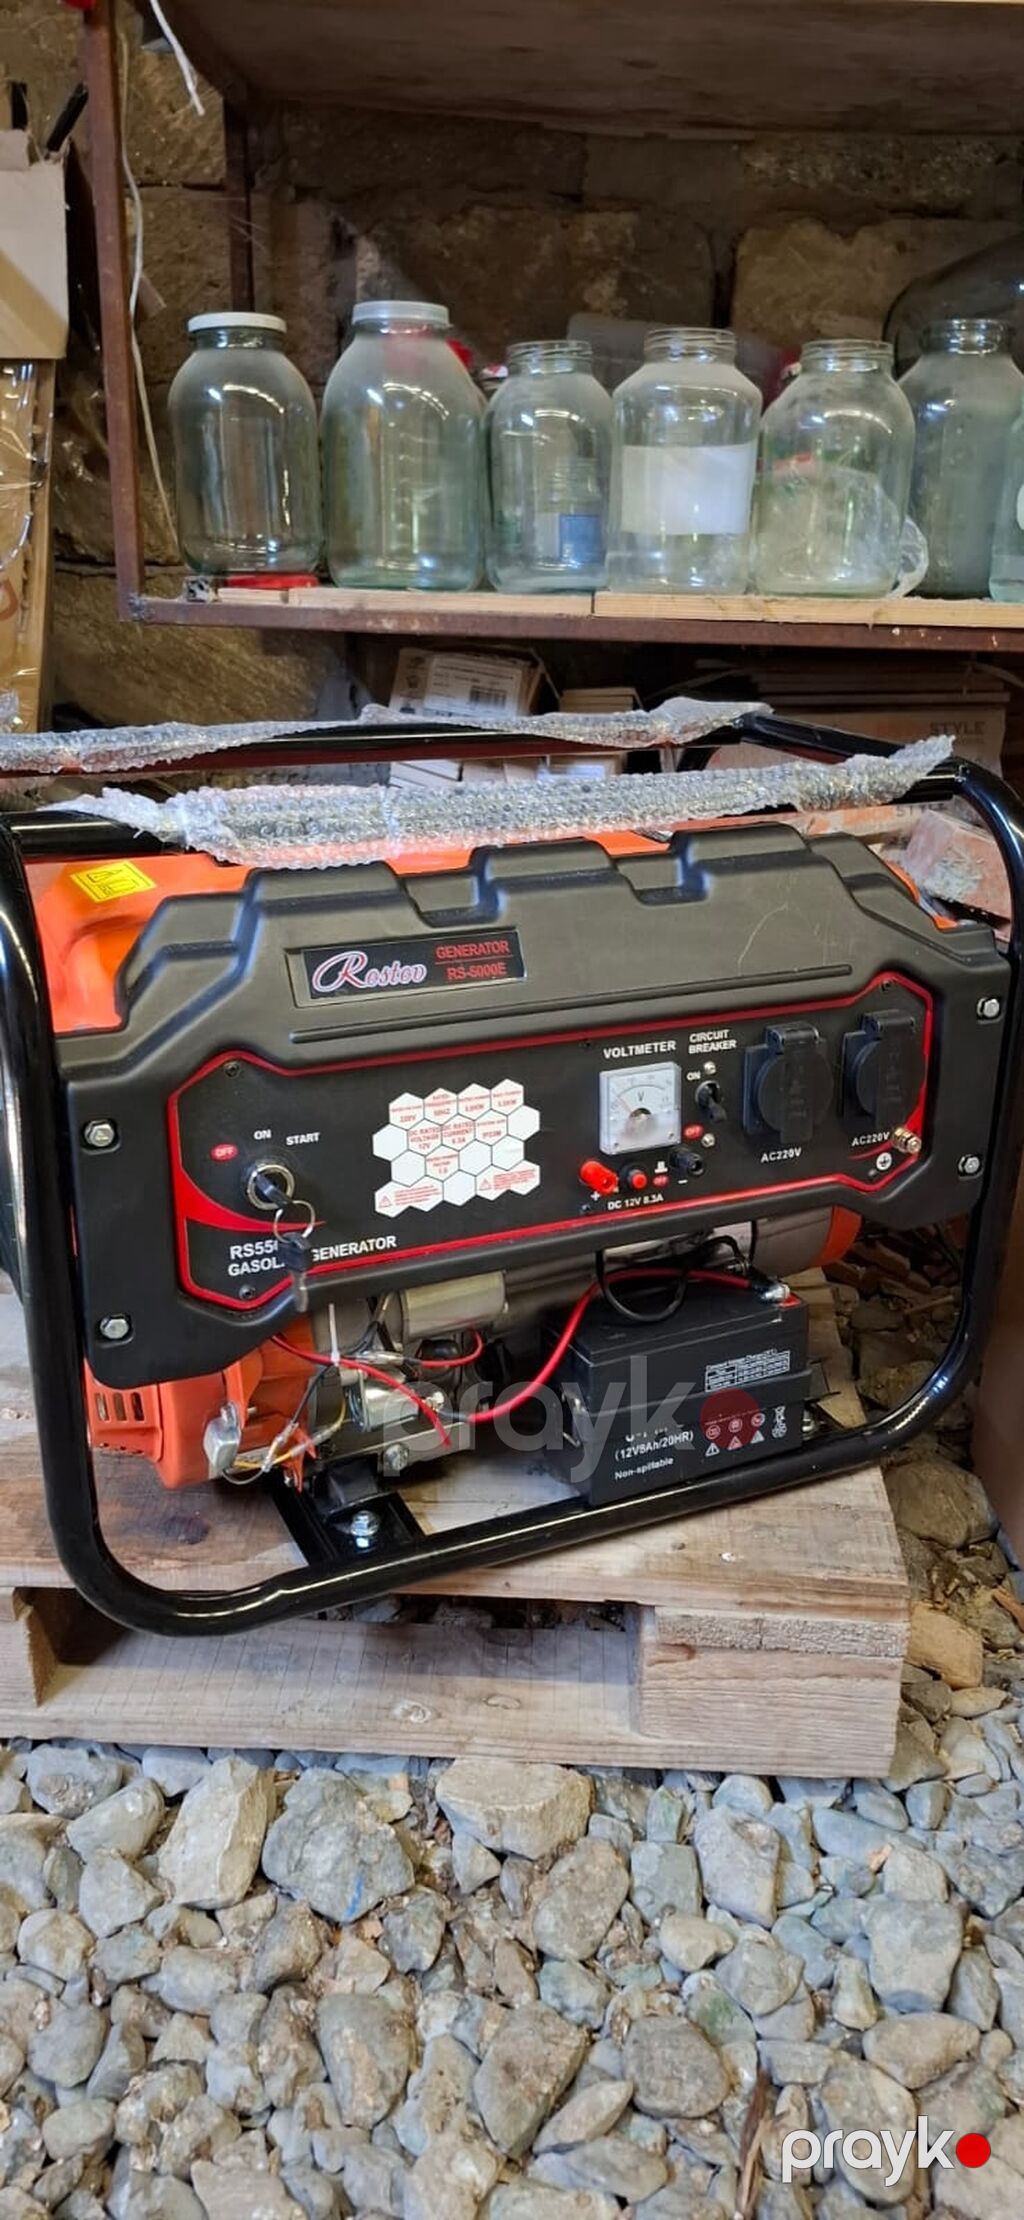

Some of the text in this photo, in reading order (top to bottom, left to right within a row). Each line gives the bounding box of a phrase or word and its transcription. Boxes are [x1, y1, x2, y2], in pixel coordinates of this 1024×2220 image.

[435, 940, 510, 959] GENERATOR
[312, 951, 427, 993] Rostov
[447, 961, 507, 980] RS-5000E
[689, 1029, 730, 1043] CIRCUIT
[603, 1040, 676, 1059] VOLTMETER
[688, 1040, 737, 1054] BREAKER
[686, 1072, 701, 1081] ON
[254, 1129, 272, 1140] ON
[286, 1132, 320, 1146] START
[852, 1132, 890, 1147] AC220V
[214, 1146, 235, 1158] OFF
[761, 1147, 802, 1163] AC220V
[607, 1193, 664, 1210] DC 12V 8.3A
[229, 1239, 279, 1260] RS55
[228, 1255, 285, 1276] GASOL
